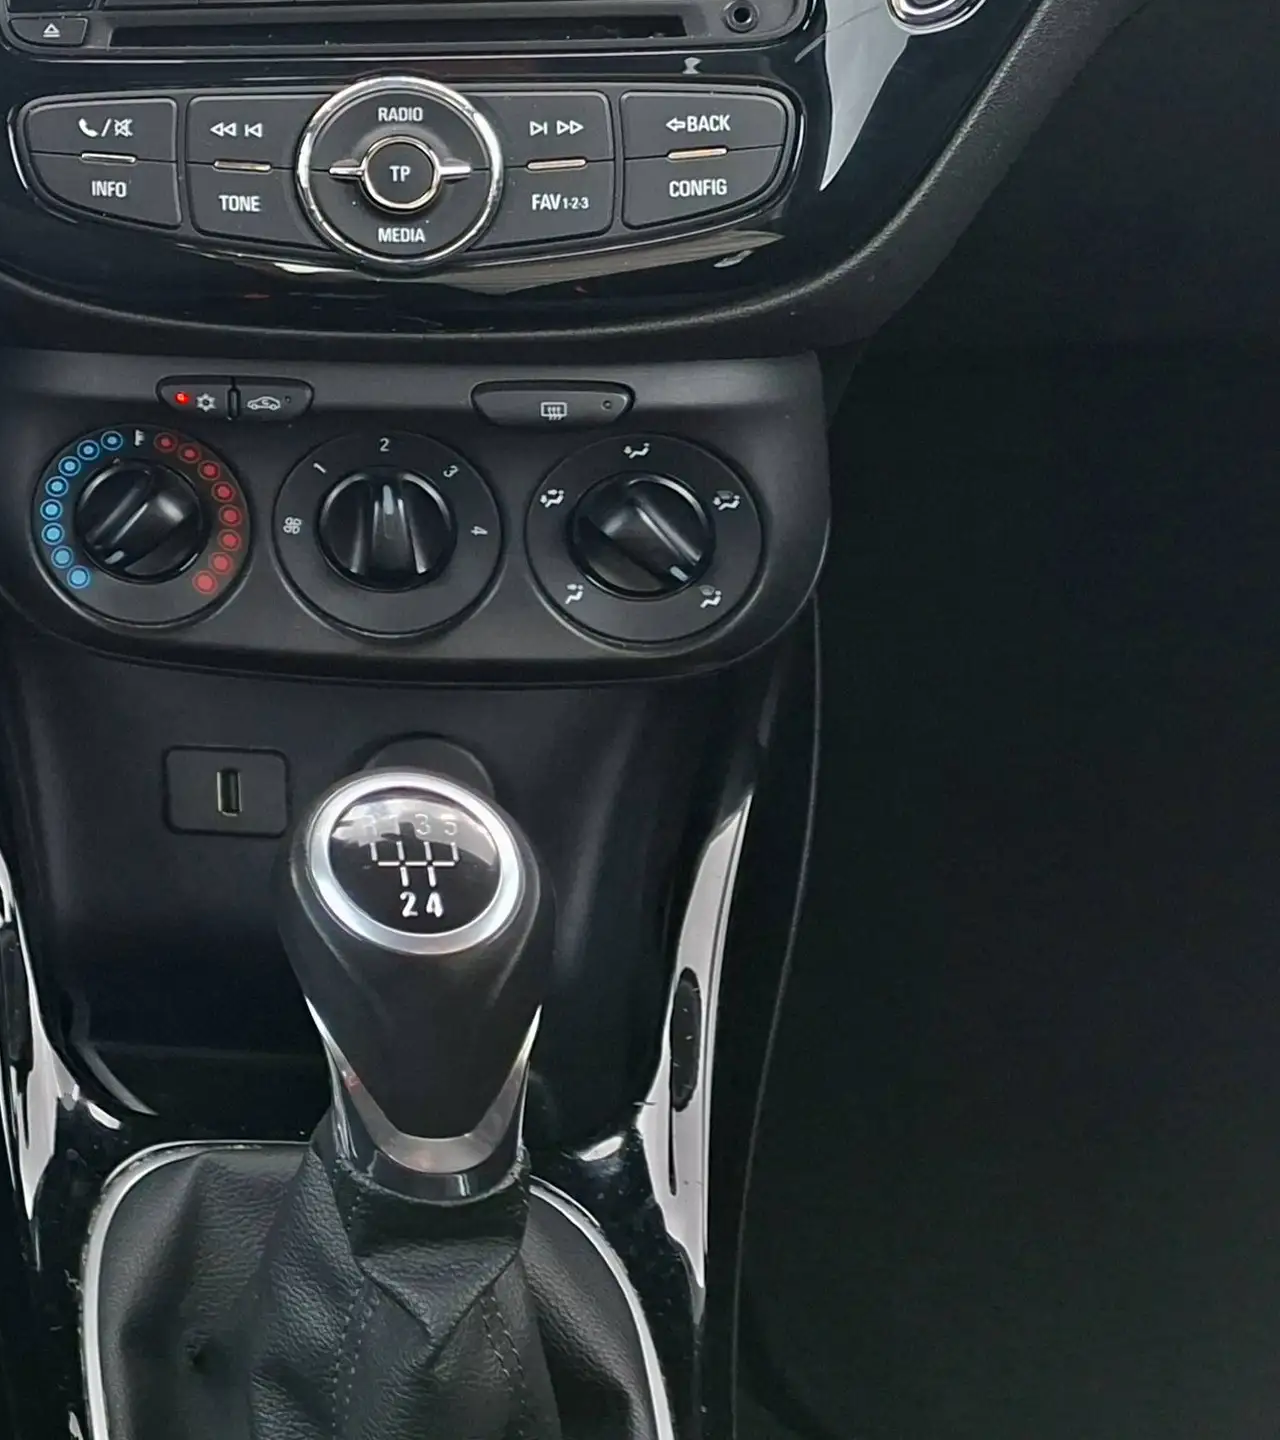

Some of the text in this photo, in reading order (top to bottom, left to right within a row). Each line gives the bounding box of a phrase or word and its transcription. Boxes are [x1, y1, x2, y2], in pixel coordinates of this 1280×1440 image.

[378, 107, 423, 122] RADIO
[687, 114, 731, 133] BACK
[389, 165, 411, 182] TP
[91, 180, 127, 198] INFO
[669, 178, 728, 198] CONFIG
[219, 195, 261, 213] TONE
[378, 227, 425, 243] MEDIA
[379, 437, 390, 452] 2
[313, 462, 326, 474] 1
[443, 465, 459, 478] 3
[471, 525, 488, 536] 4
[415, 813, 431, 836] 3
[400, 891, 444, 918] 2 4
